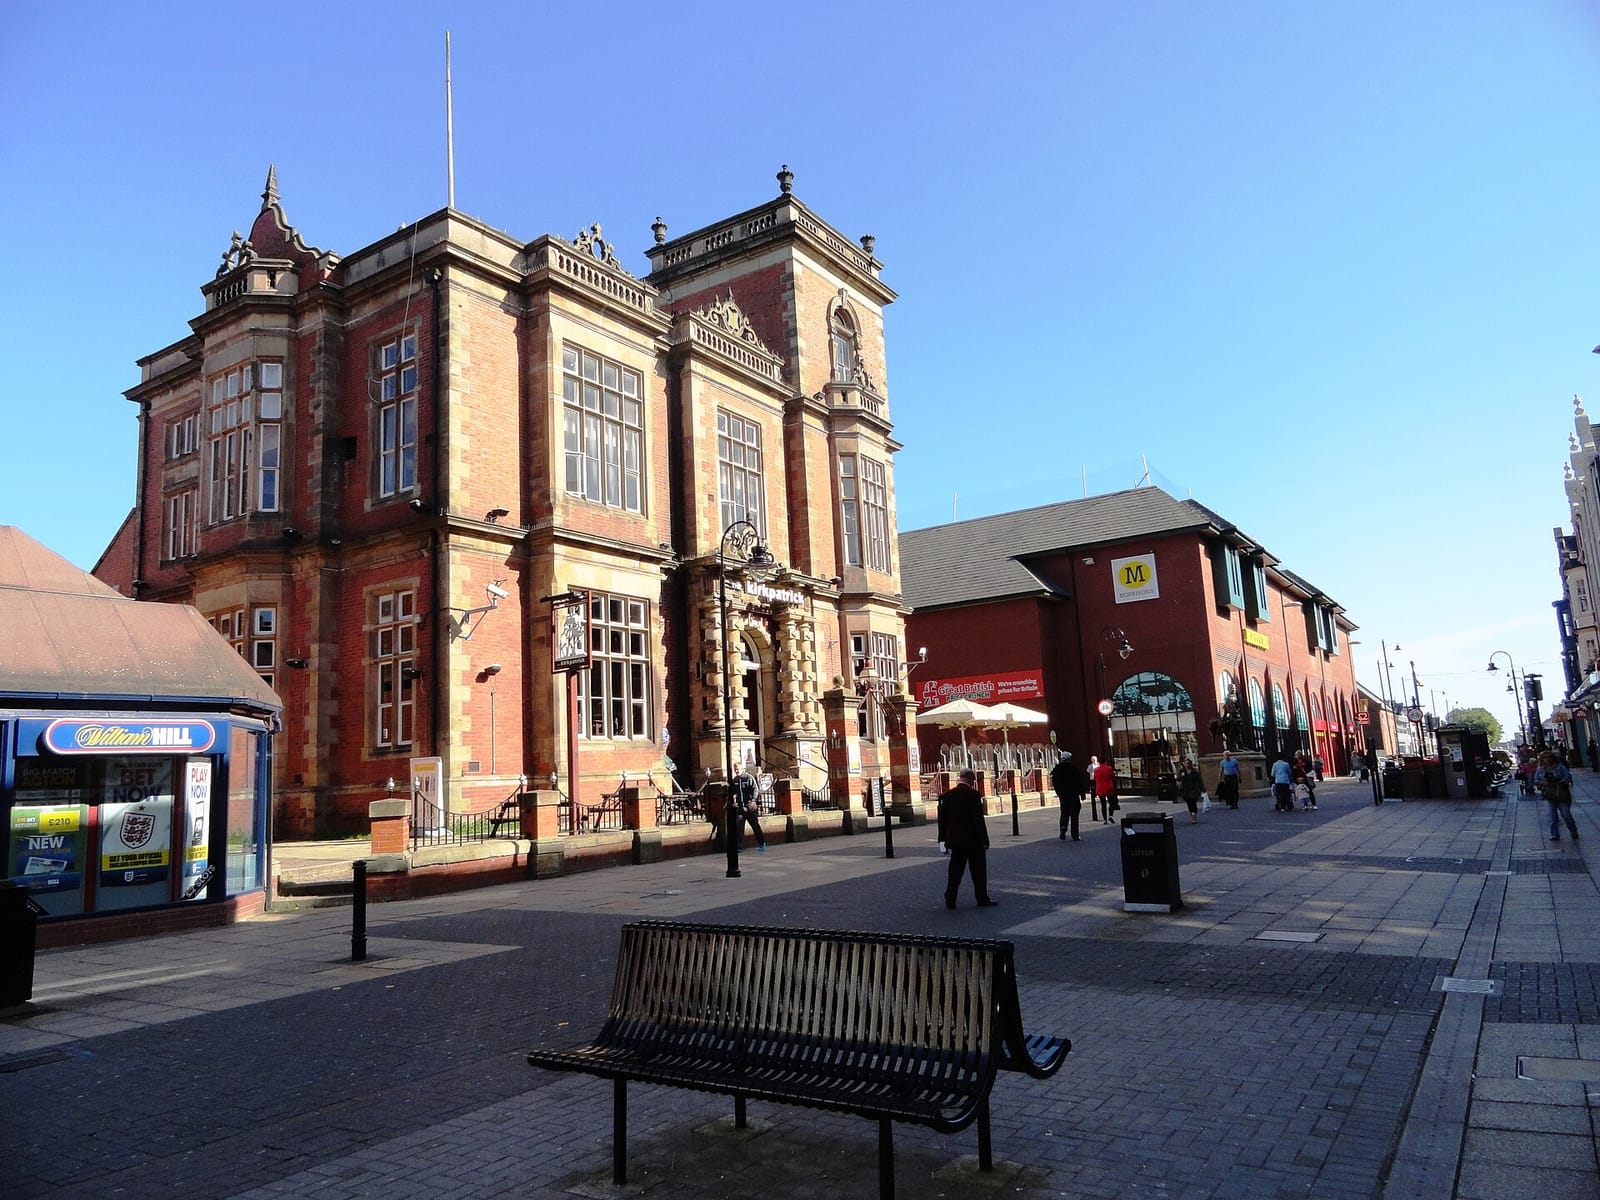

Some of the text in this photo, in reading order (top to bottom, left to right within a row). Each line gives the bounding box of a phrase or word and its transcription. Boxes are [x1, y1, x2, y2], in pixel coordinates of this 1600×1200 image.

[1125, 565, 1145, 584] M
[746, 581, 804, 604] kirkpatrick
[938, 681, 995, 695] Great British
[75, 724, 192, 747] William HILL
[121, 769, 156, 785] BET
[191, 768, 208, 782] PLAY
[113, 786, 161, 803] NOW
[191, 785, 208, 799] NOW
[48, 818, 71, 827] £210
[28, 836, 64, 850] NEW
[195, 865, 216, 887] SLOTS
